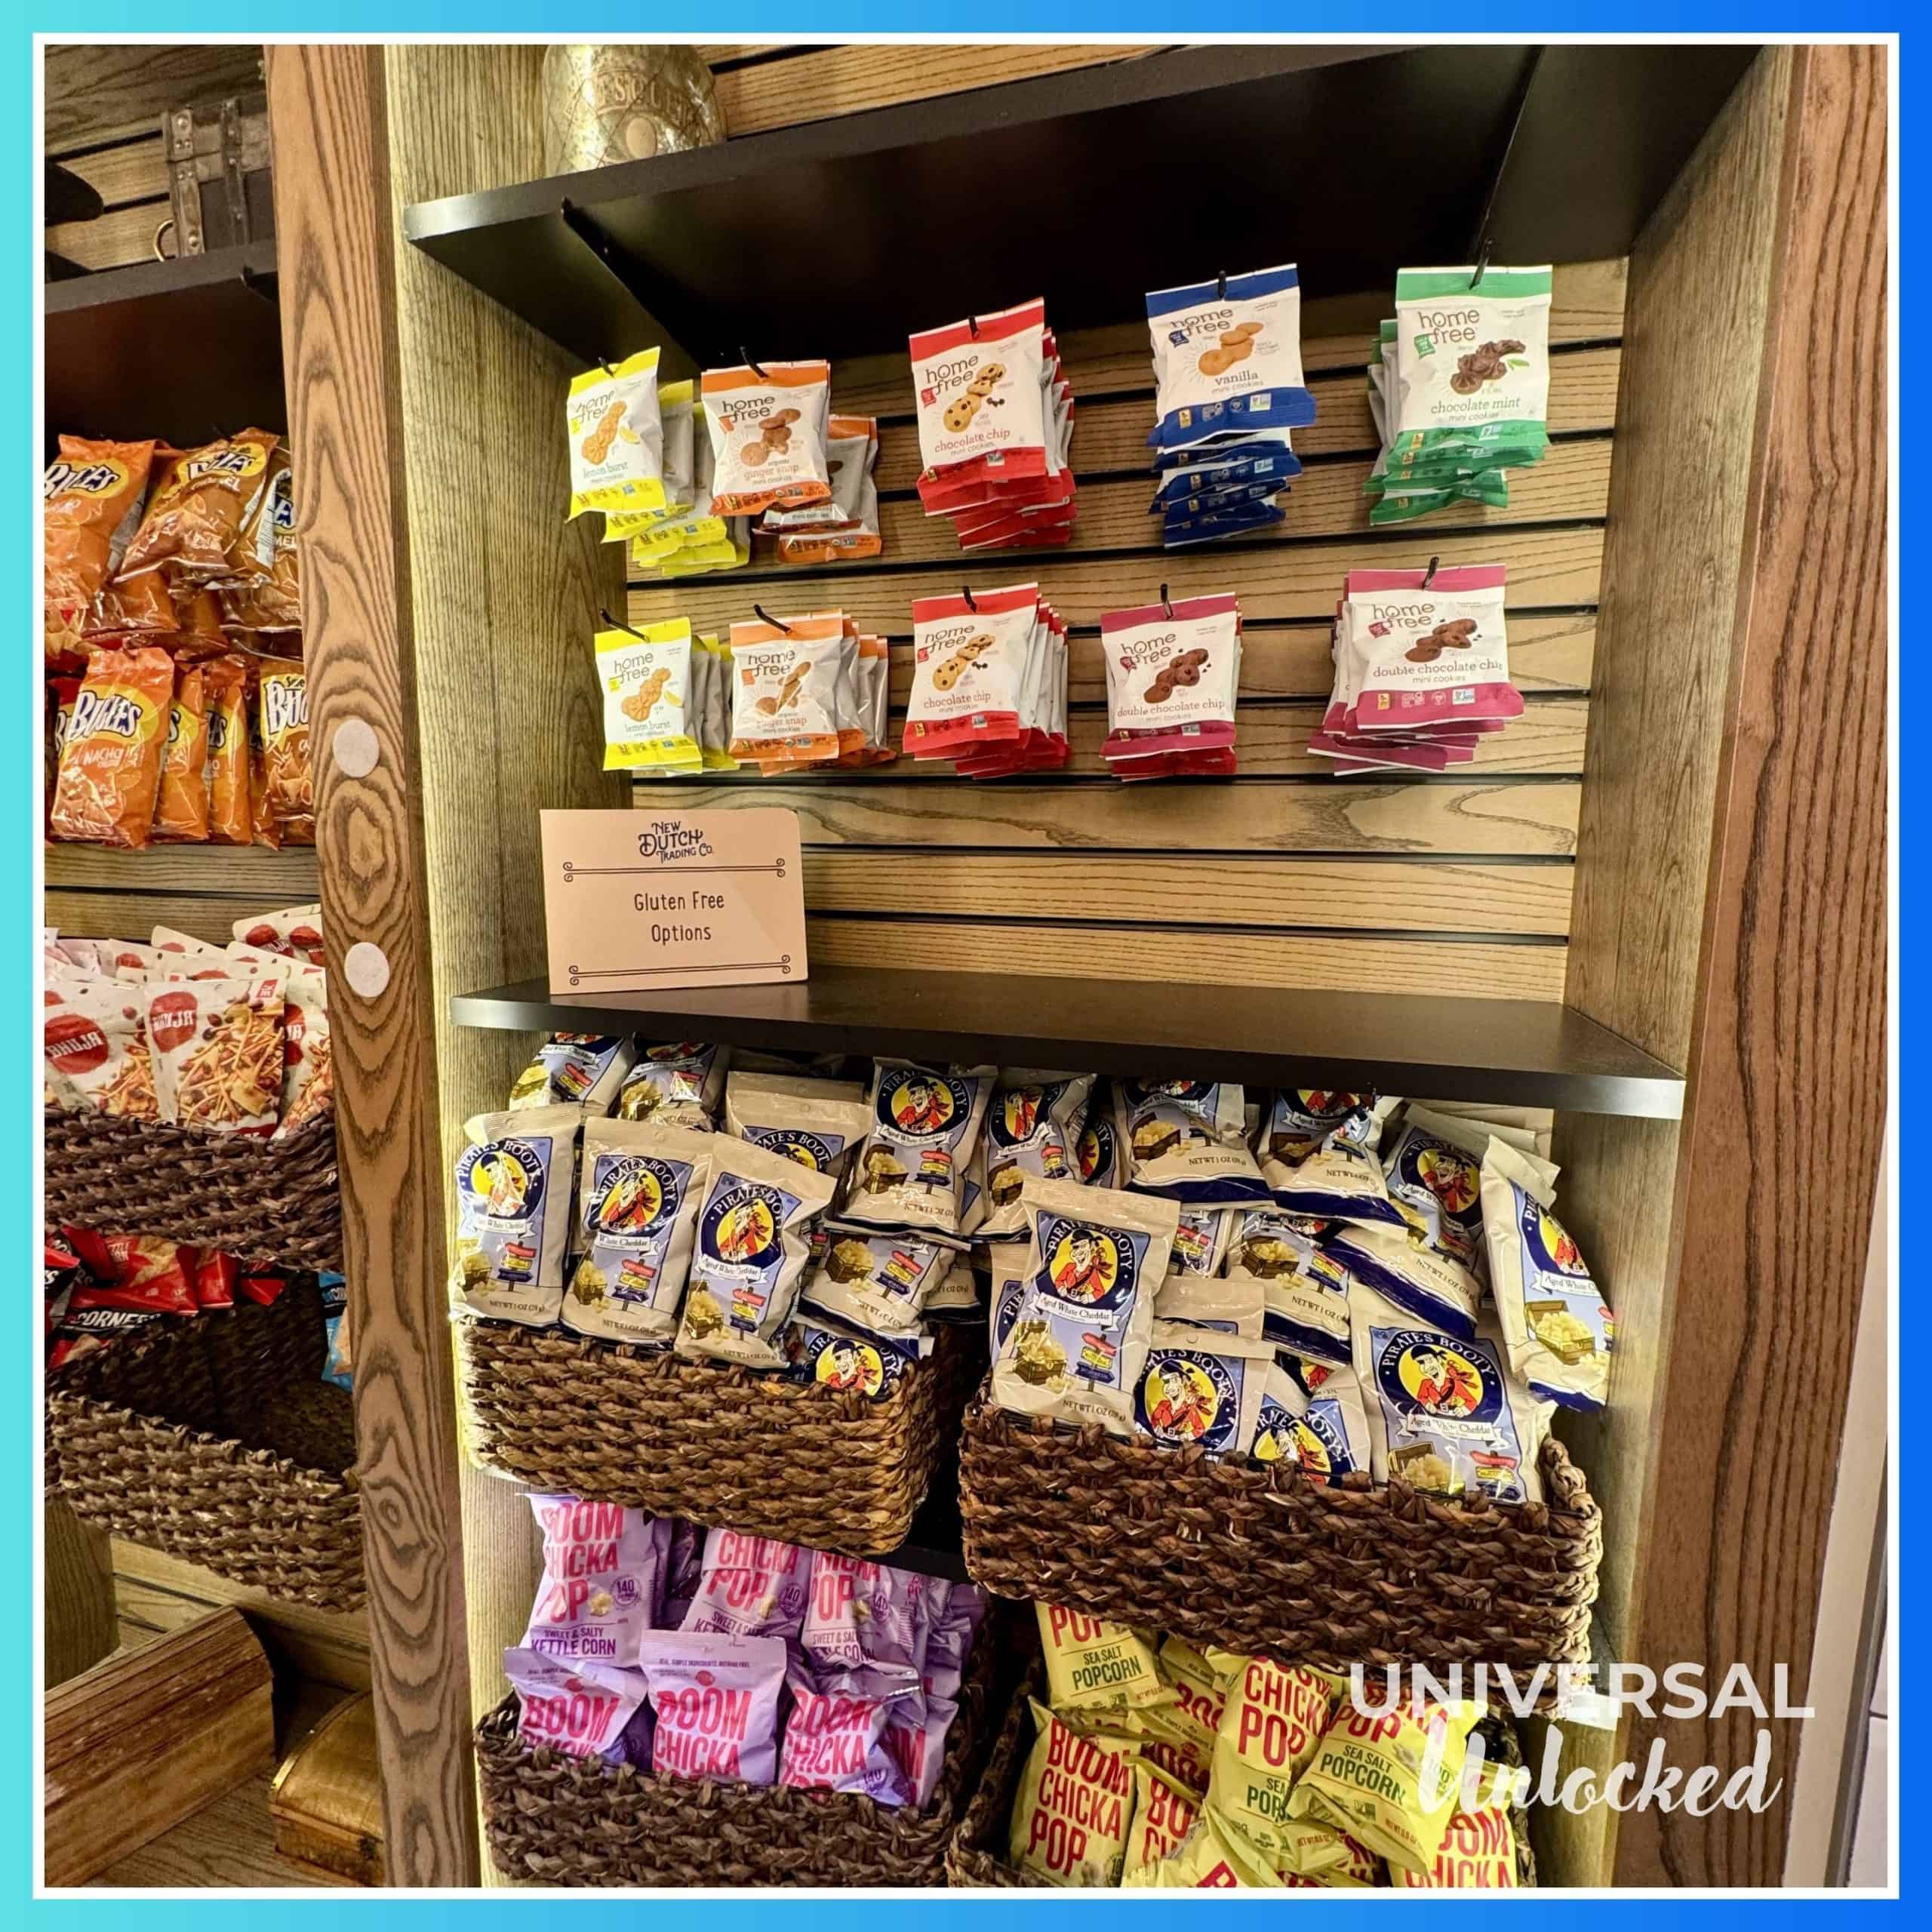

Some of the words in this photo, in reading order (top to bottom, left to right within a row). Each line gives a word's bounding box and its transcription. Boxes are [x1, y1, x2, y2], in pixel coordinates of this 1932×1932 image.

[1171, 307, 1234, 328] home
[1418, 309, 1480, 329] home
[1183, 321, 1231, 337] free
[1431, 326, 1476, 345] free
[926, 355, 979, 383] home
[1215, 371, 1259, 386] vanilla
[934, 371, 974, 395] free
[722, 396, 775, 413] home
[1431, 399, 1490, 414] chocolate
[1492, 397, 1521, 408] mint
[731, 406, 771, 423] free
[935, 433, 985, 454] chocolate
[986, 429, 1011, 444] chip
[744, 467, 775, 481] ginger
[1373, 603, 1435, 620] home
[1386, 615, 1432, 629] free
[924, 625, 975, 644] home
[1121, 633, 1177, 655] home
[928, 635, 967, 654] free
[614, 651, 654, 674] home
[748, 649, 795, 666] home
[620, 666, 650, 684] free
[752, 662, 791, 677] free
[1374, 666, 1416, 678] double
[1417, 661, 1476, 674] chocolate
[924, 694, 972, 709] chocolate
[973, 691, 991, 702] chip
[1117, 706, 1149, 718] double
[1150, 700, 1200, 715] chocolate
[1201, 697, 1225, 709] chip
[625, 722, 648, 734] lemon
[649, 720, 670, 731] burst
[783, 716, 808, 728] snap
[651, 820, 681, 835] NEW
[638, 828, 703, 857] DUTCH
[656, 847, 697, 864] TRADING
[634, 893, 686, 912] Gluten
[692, 891, 724, 909] Free
[651, 924, 712, 946] Options
[1057, 1300, 1078, 1316] White
[1079, 1307, 1110, 1321] Cheddar
[1382, 1331, 1434, 1367] PIRATE'S
[1439, 1337, 1496, 1377] BOOTY
[1063, 1400, 1078, 1410] NET
[1096, 1405, 1107, 1416] OZ
[1411, 1416, 1432, 1429] Aged
[718, 1531, 799, 1577] CHICKA
[617, 1579, 635, 1595] 140
[706, 1568, 771, 1613] POP
[783, 1589, 800, 1602] 140
[712, 1611, 738, 1630] SWEET
[580, 1627, 604, 1637] SALTY
[842, 1630, 856, 1643] SAL
[531, 1640, 578, 1657] KETTLE
[581, 1638, 616, 1656] CORN
[1083, 1651, 1100, 1666] SEA
[1101, 1645, 1123, 1661] SALT
[1072, 1656, 1143, 1691] POPCORN
[521, 1694, 622, 1745] BOOM
[657, 1687, 752, 1742] BOOM
[1238, 1703, 1306, 1767] POP
[654, 1724, 741, 1777] CHICKA
[1343, 1745, 1364, 1762] SEA
[1364, 1752, 1393, 1774] SALT
[1320, 1752, 1407, 1806] POPCORN
[1038, 1767, 1121, 1842] CHICKA
[1026, 1807, 1088, 1878] POP
